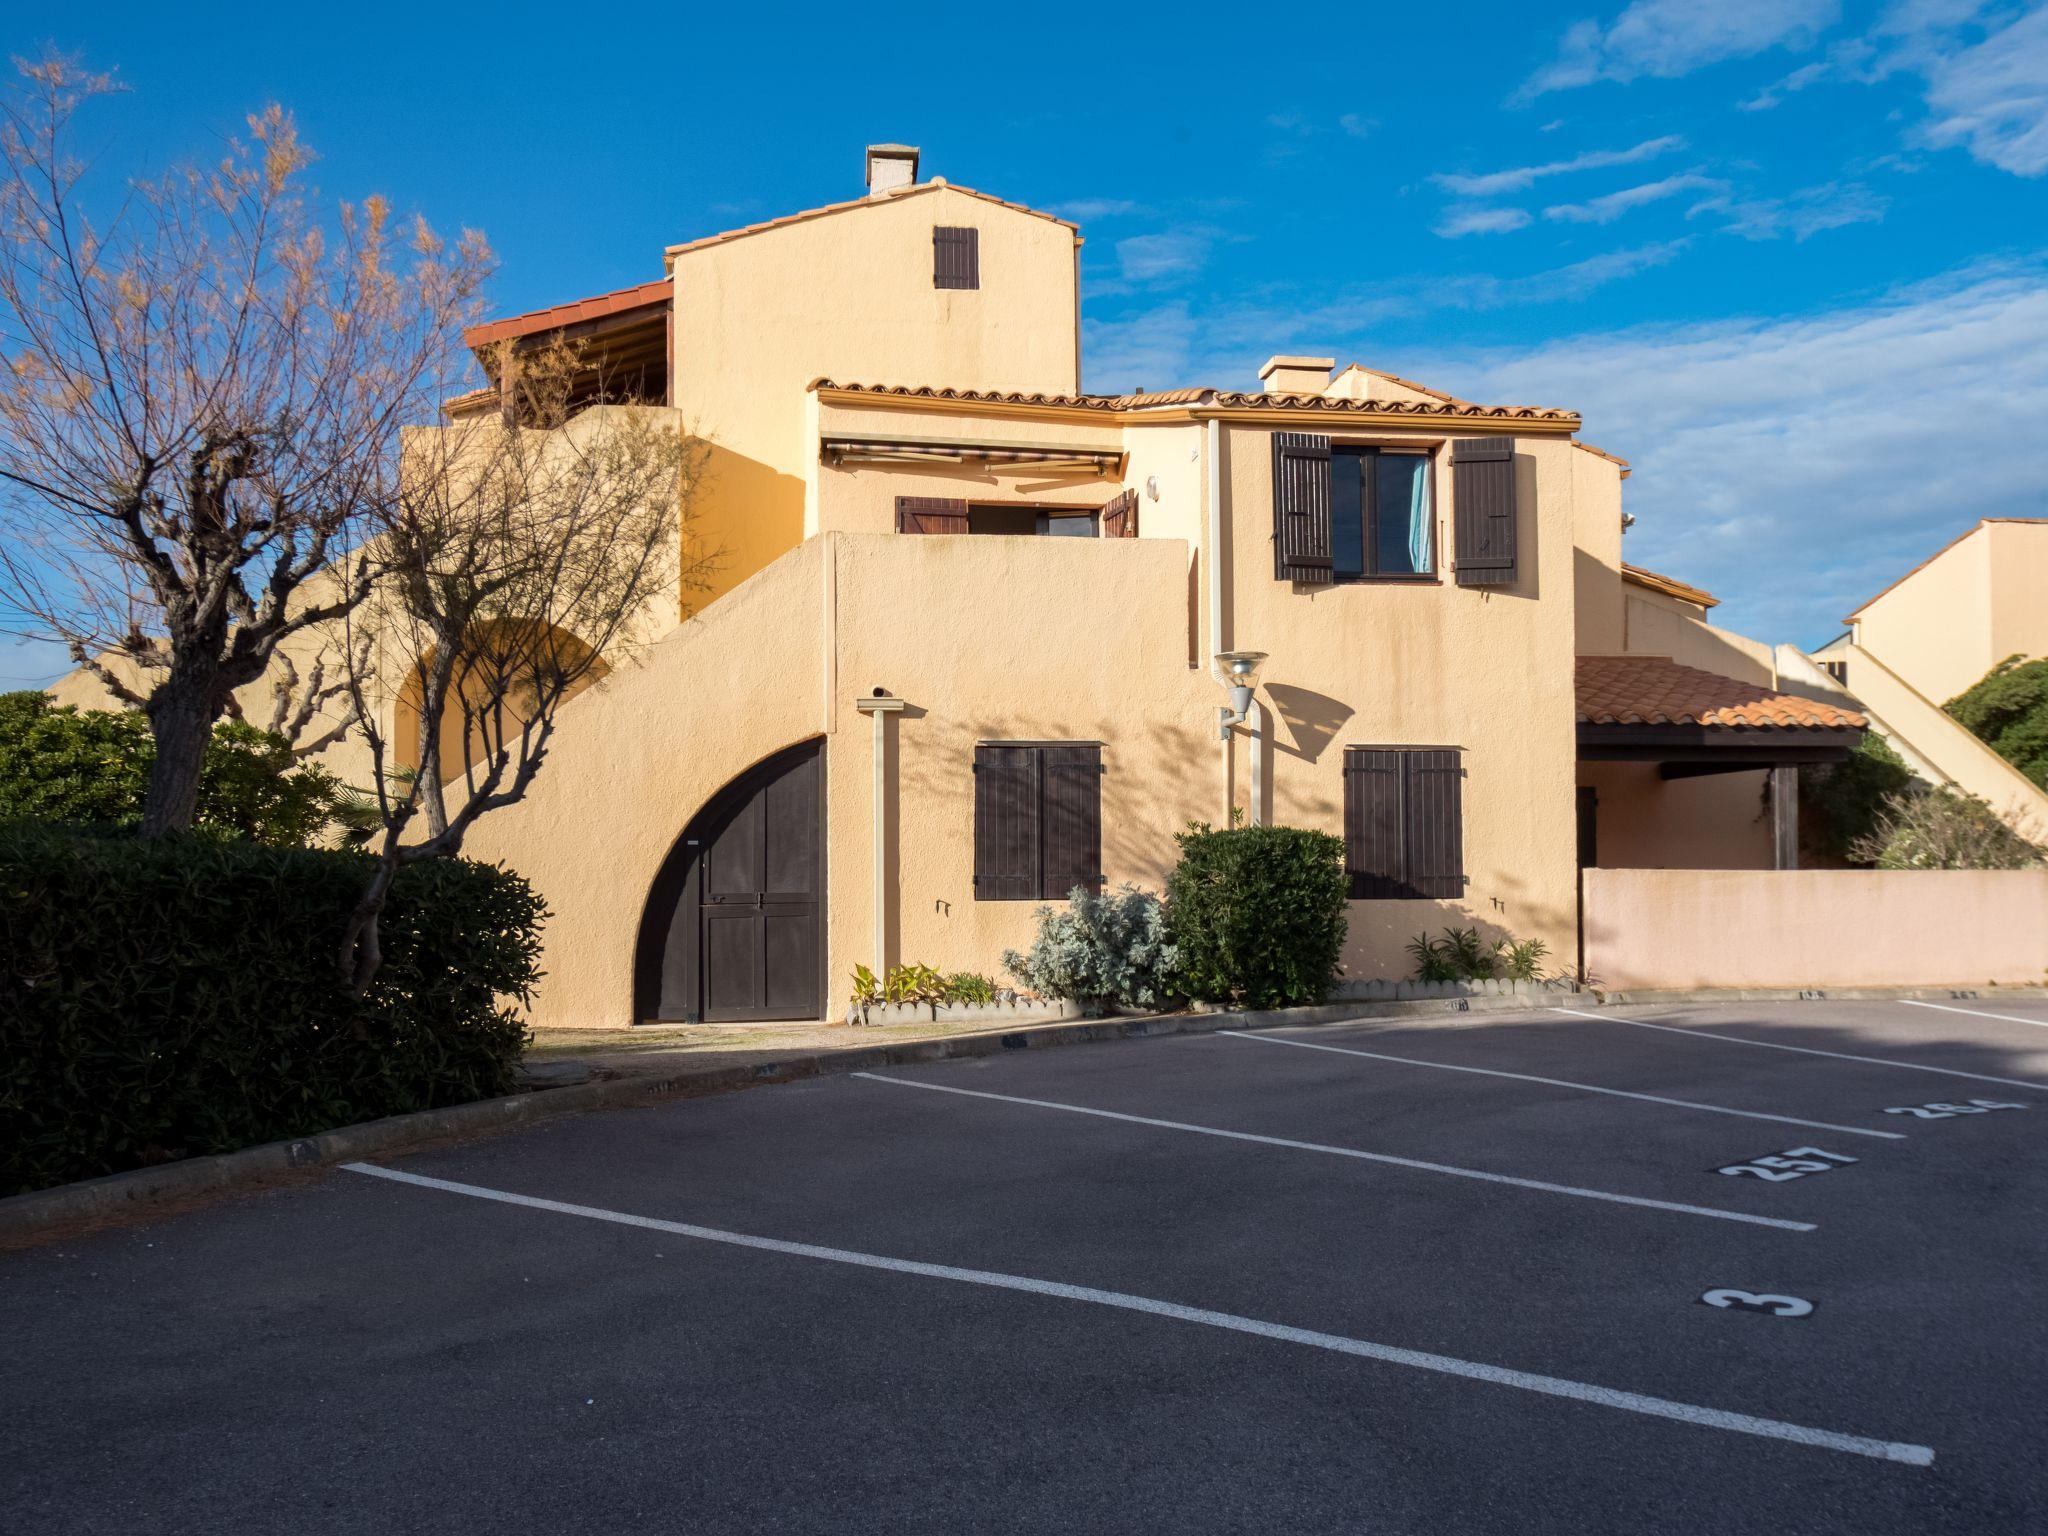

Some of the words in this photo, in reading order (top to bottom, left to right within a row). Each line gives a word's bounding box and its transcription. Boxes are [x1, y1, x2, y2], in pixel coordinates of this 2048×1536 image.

[1883, 1098, 2029, 1119] 284
[1719, 1146, 1859, 1182] 257
[1702, 1288, 1813, 1317] 3
